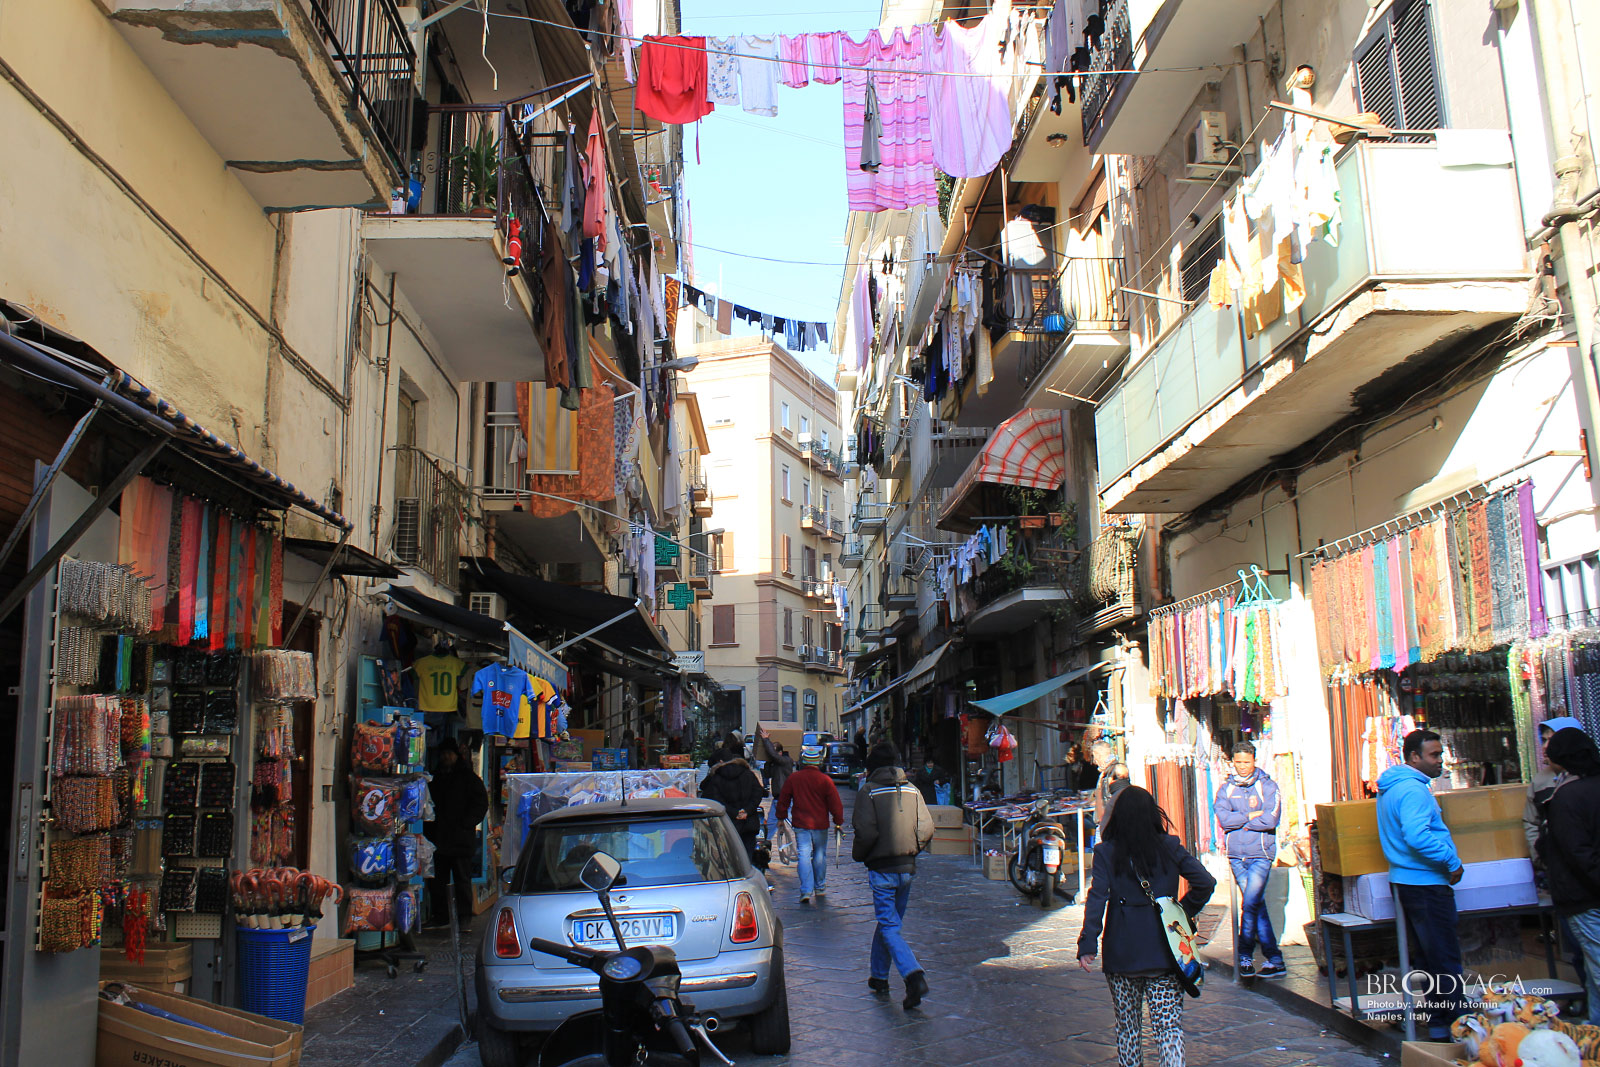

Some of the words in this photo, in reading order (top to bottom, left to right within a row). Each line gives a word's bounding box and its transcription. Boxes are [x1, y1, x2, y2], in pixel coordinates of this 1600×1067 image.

[527, 648, 540, 670] EURO
[541, 659, 556, 681] SPORT
[430, 671, 452, 696] 10
[691, 914, 718, 922] COOPER
[586, 921, 604, 939] CK
[133, 1050, 187, 1067] REAKER
